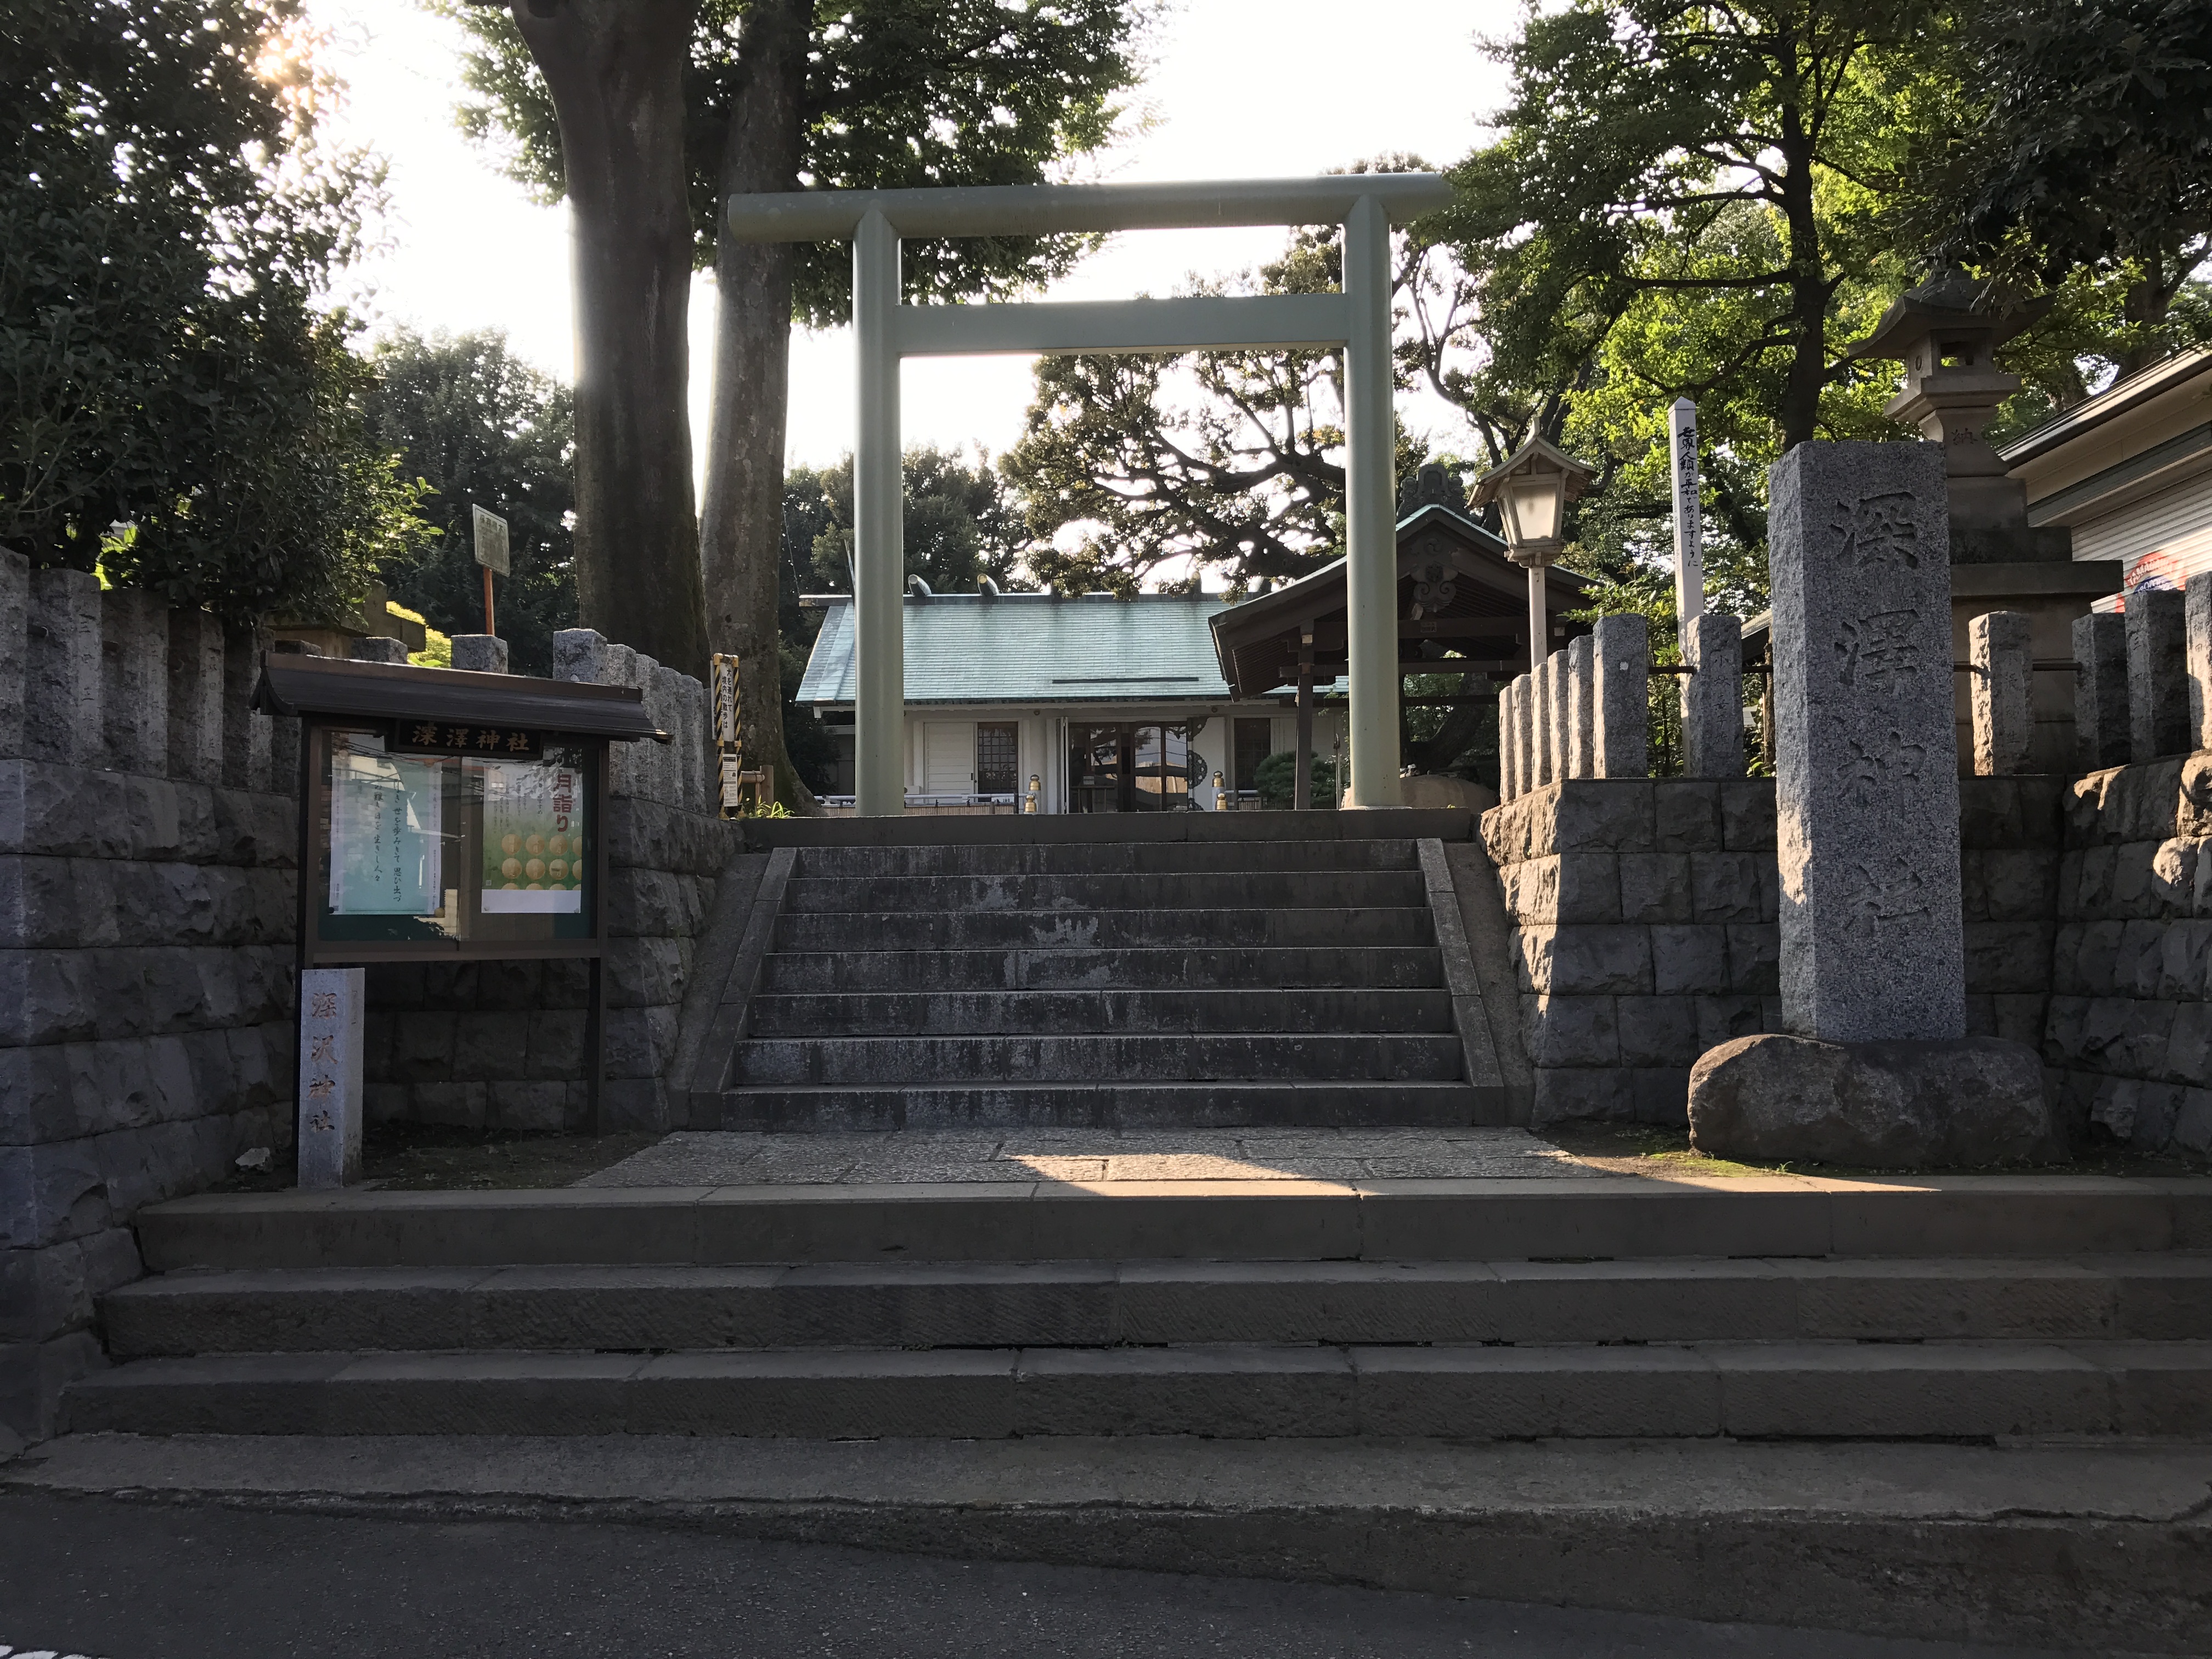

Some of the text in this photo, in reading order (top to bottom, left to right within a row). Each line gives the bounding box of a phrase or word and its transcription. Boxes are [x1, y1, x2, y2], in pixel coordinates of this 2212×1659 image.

[1678, 426, 1699, 567] 世界人類が平和でありますように
[412, 721, 529, 752] 深澤神社
[1830, 492, 1929, 933] 深澤神社
[308, 992, 338, 1133] 深沢神社
